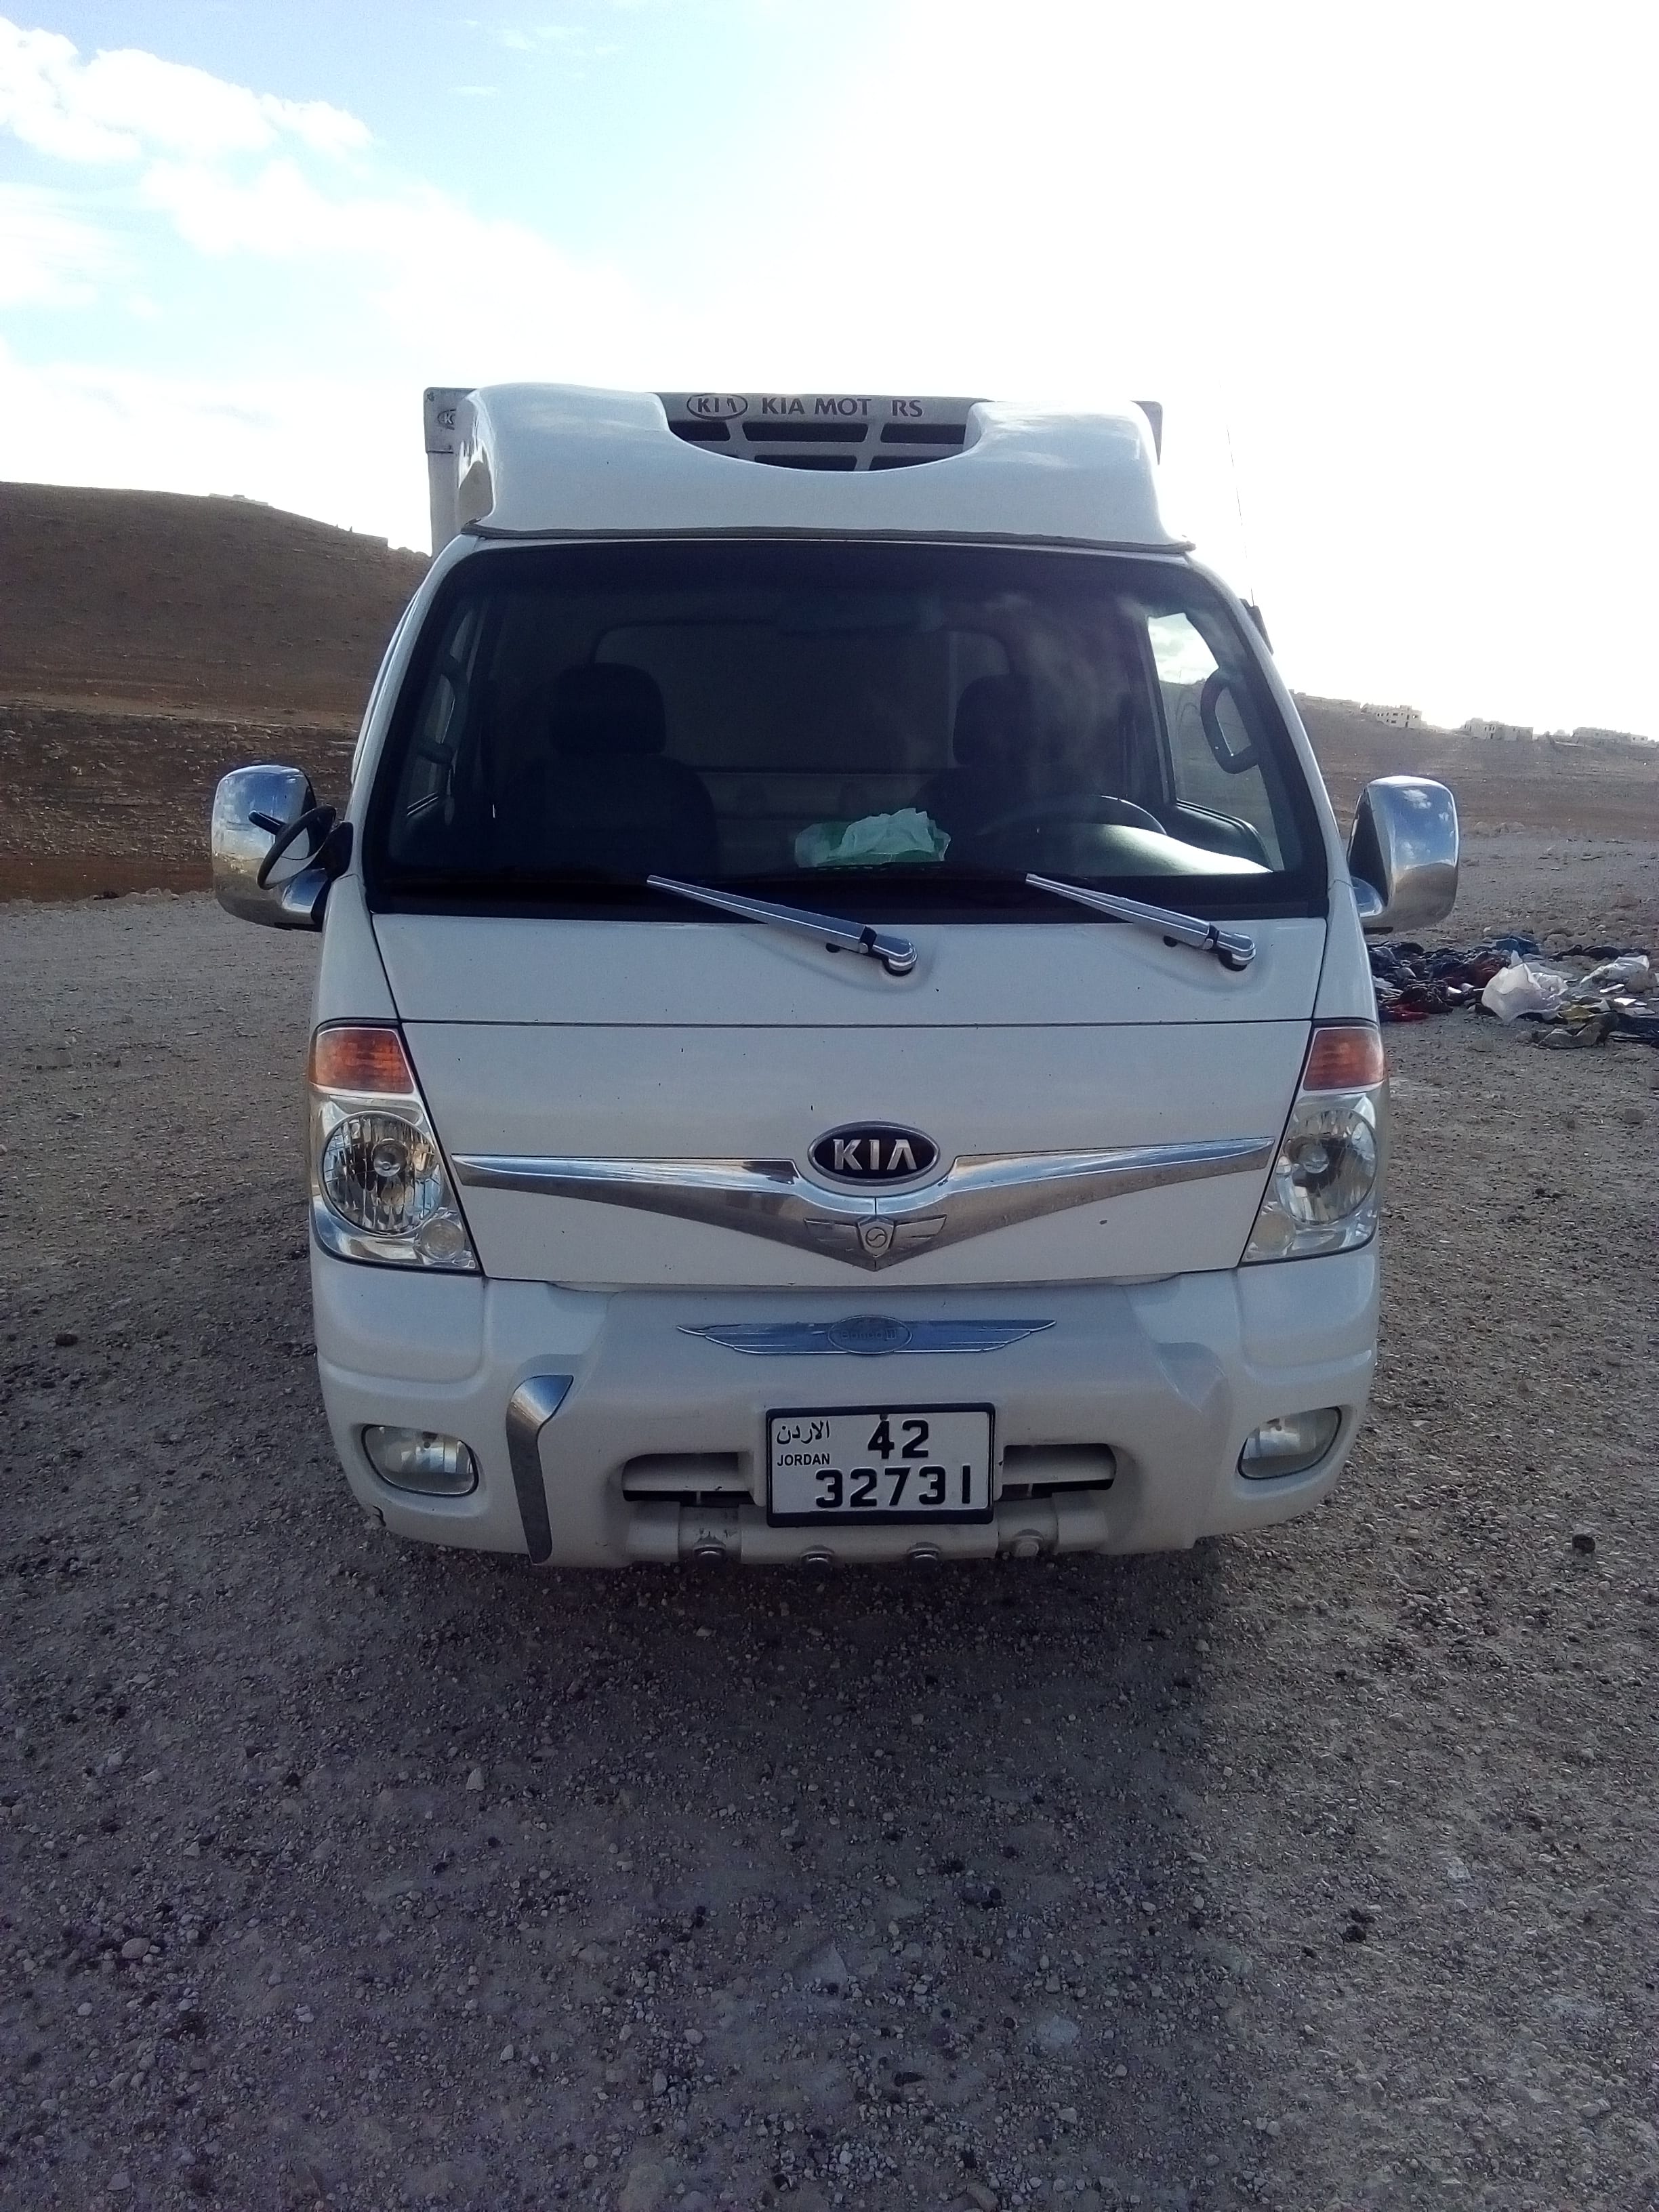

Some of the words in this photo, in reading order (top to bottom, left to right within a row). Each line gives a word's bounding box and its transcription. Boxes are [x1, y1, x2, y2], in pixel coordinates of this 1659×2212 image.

[697, 397, 738, 413] KIA
[761, 396, 806, 415] KIA
[834, 1138, 918, 1171] KIA
[867, 1418, 930, 1460] 42
[777, 1452, 831, 1467] JORDAN
[815, 1465, 971, 1509] 32731
